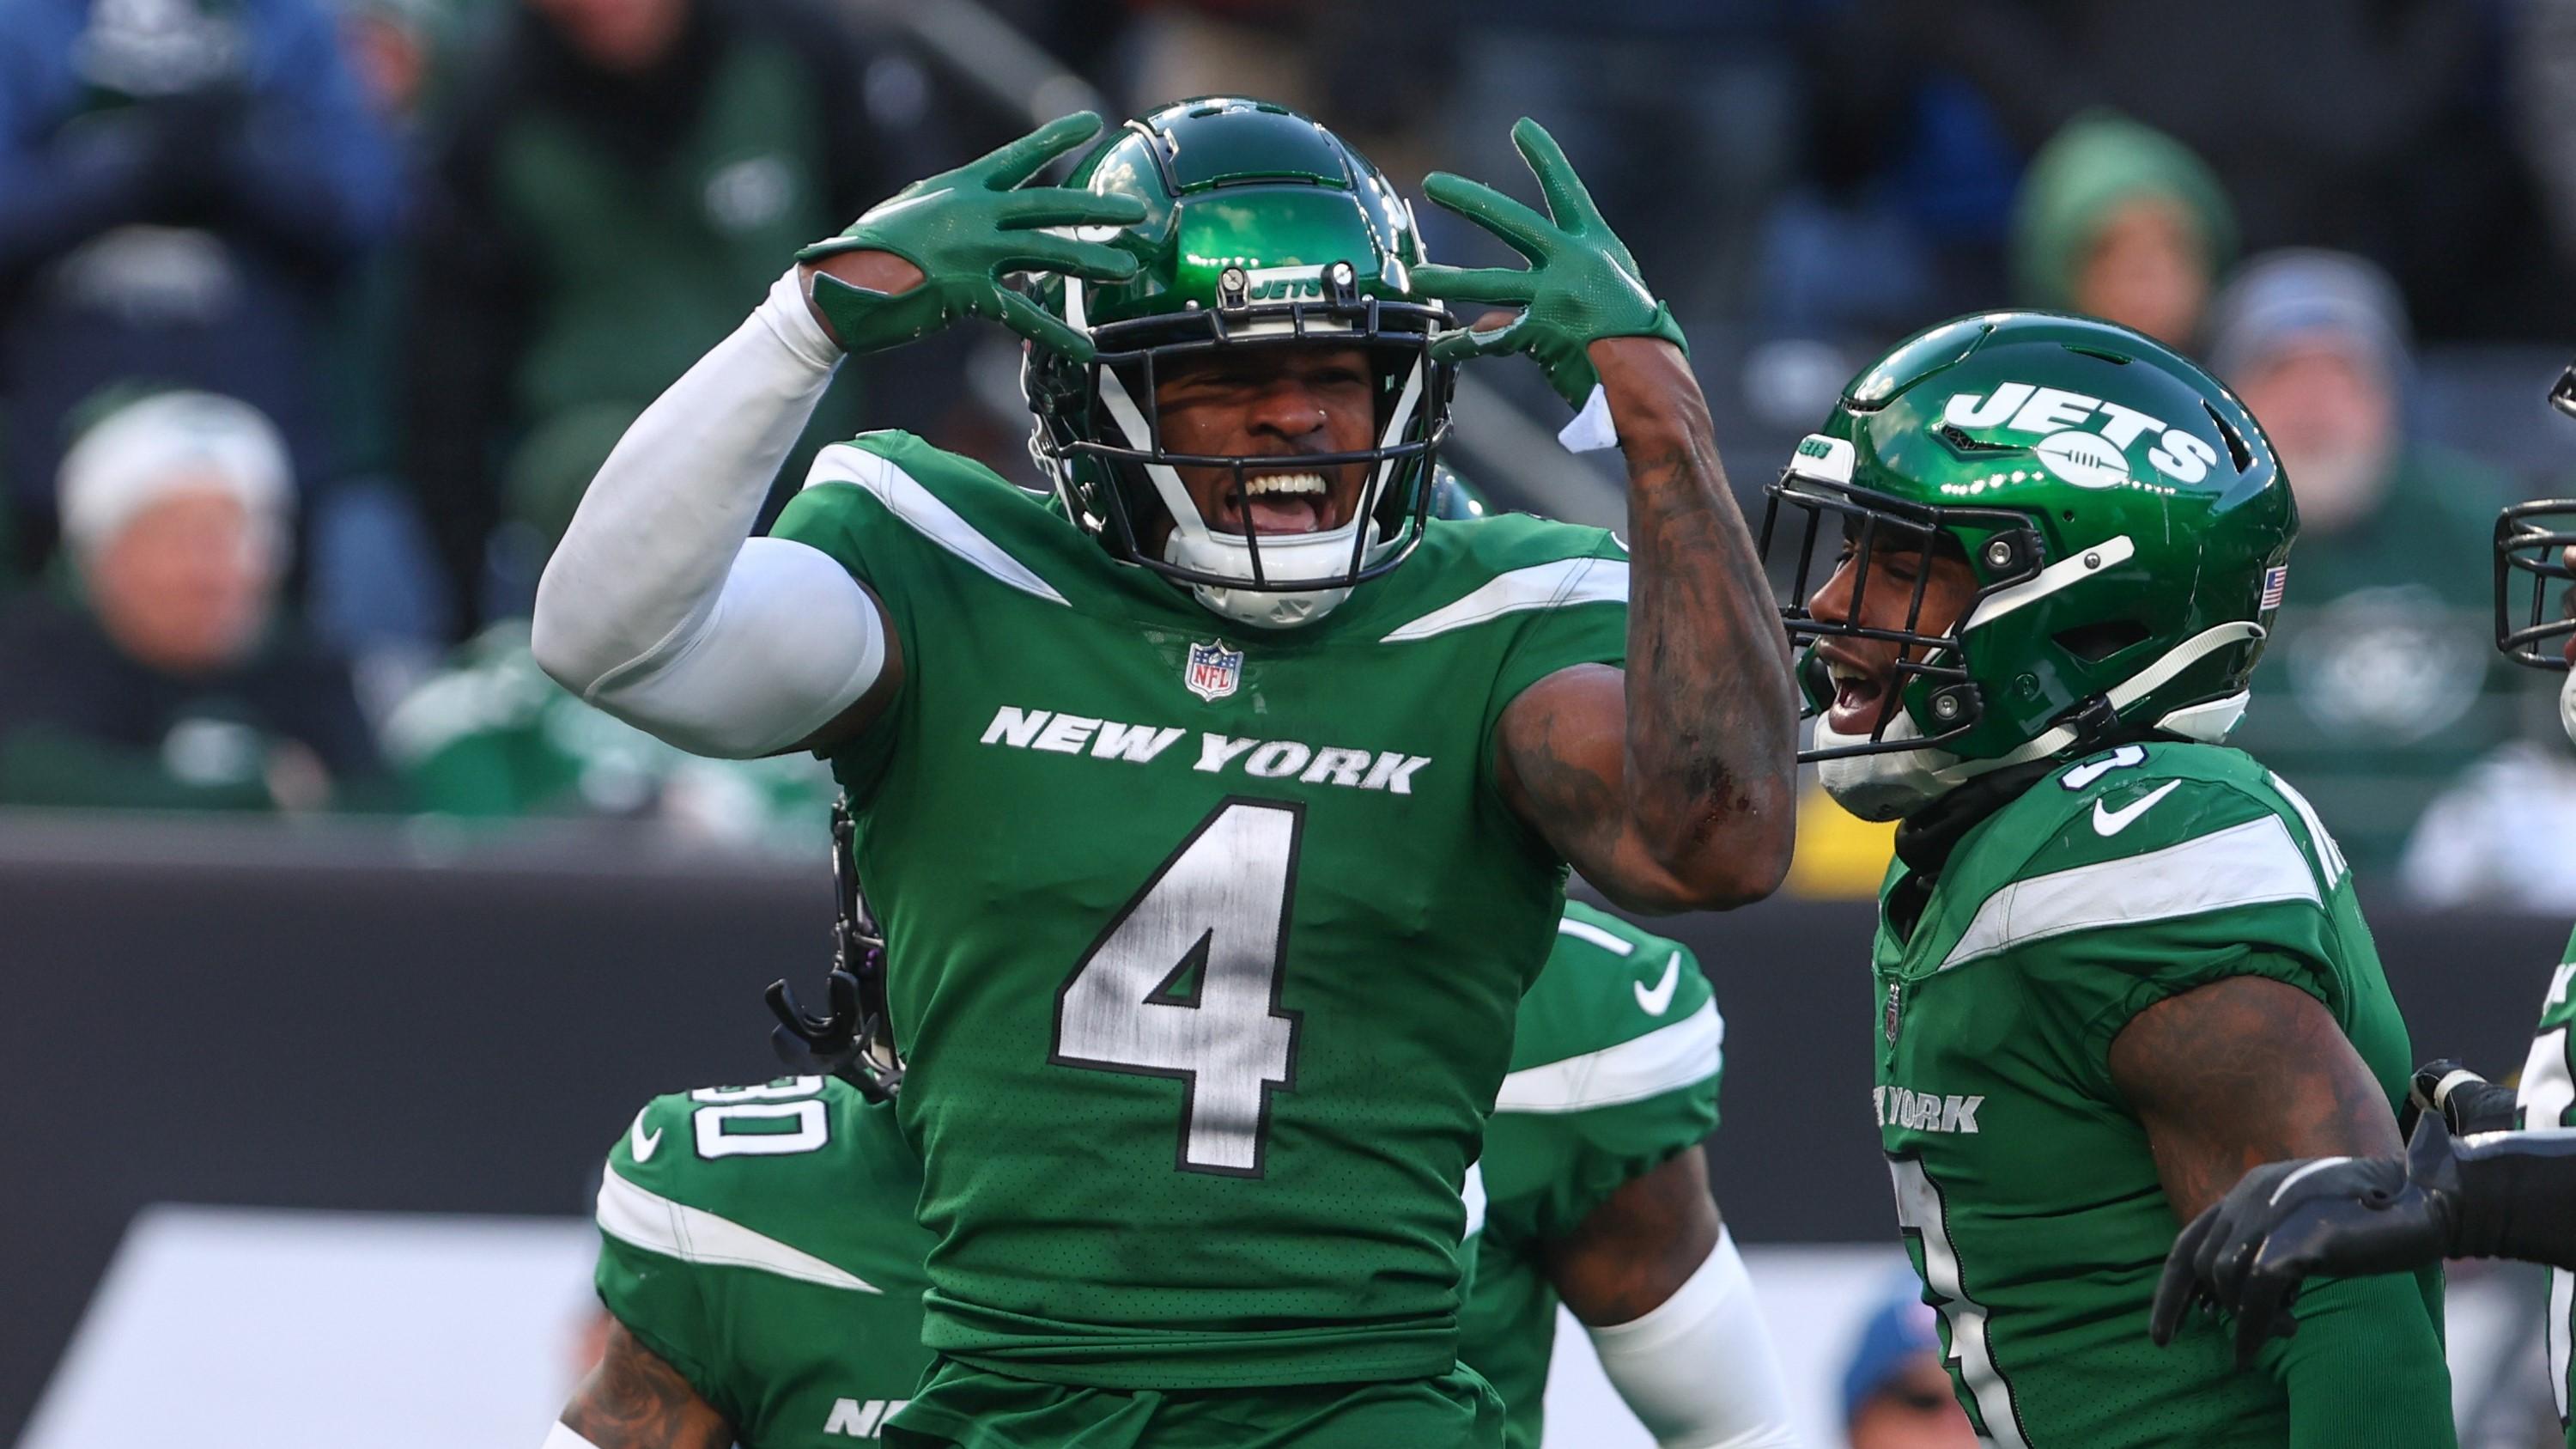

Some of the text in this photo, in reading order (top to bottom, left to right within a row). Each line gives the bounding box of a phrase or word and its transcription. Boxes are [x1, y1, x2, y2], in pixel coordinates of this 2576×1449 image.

[1250, 277, 1321, 300] JETS
[1943, 381, 2219, 484] JETS
[1194, 664, 1230, 689] NFL
[981, 706, 1431, 795] NEW YORK
[1047, 794, 1307, 1179] 4
[1889, 1086, 1985, 1134] YORK
